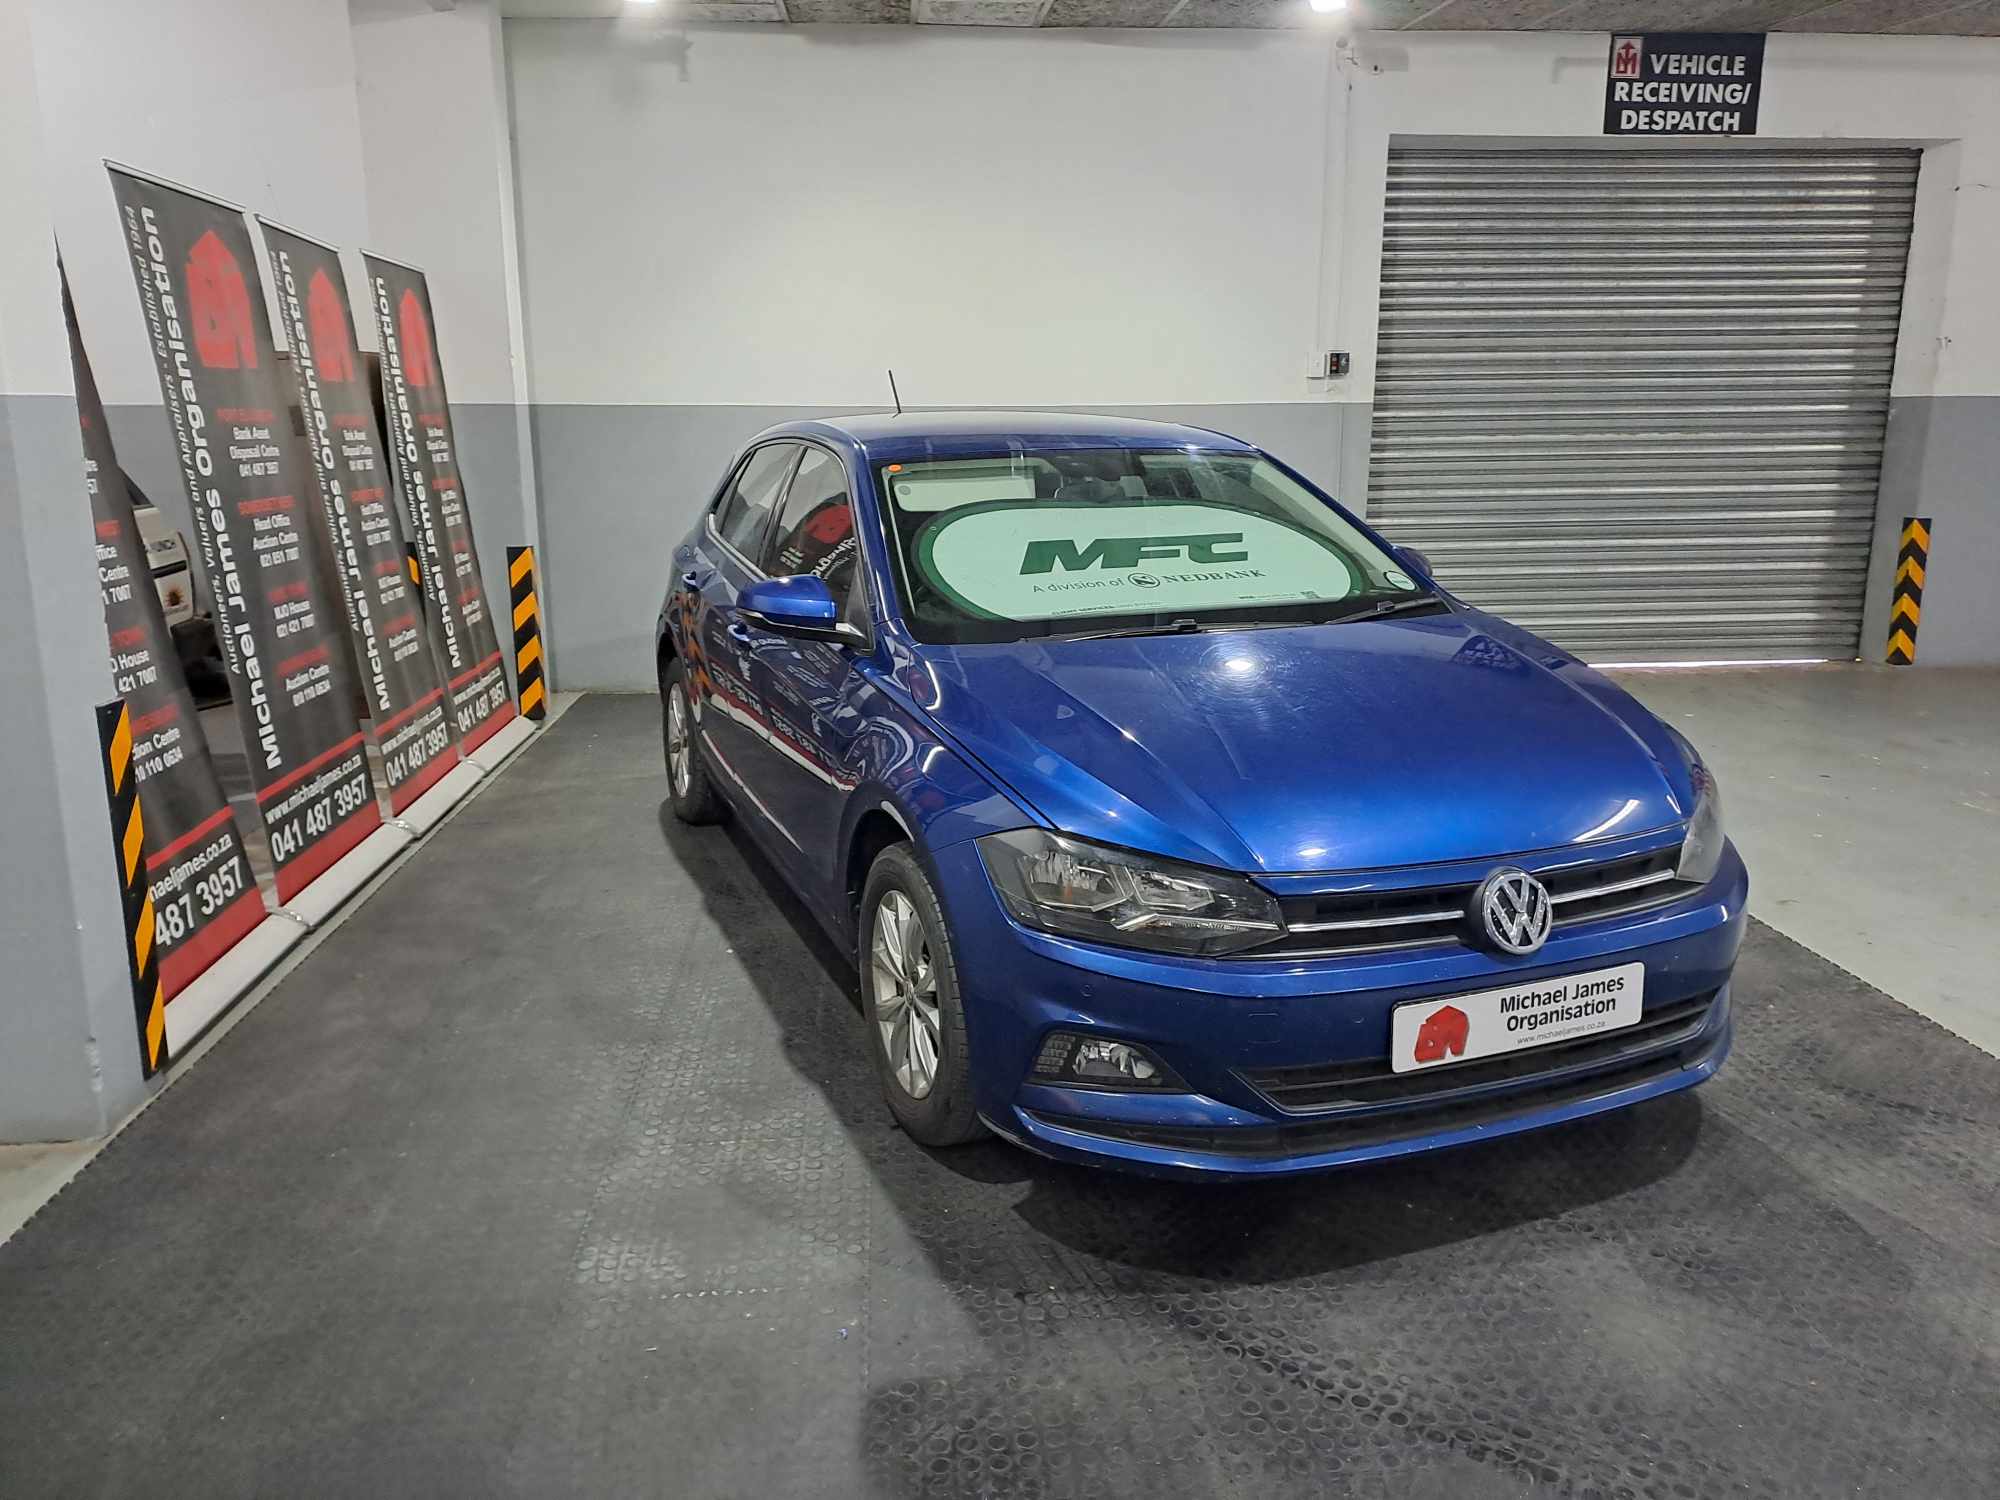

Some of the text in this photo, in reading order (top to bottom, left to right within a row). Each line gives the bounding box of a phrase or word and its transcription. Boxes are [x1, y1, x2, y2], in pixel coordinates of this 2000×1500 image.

[1614, 81, 1752, 104] RECEIVING/
[1650, 54, 1746, 76] VEHICLE
[1620, 109, 1741, 131] DESPATCH
[134, 254, 168, 358] Established
[280, 251, 334, 469] Organisation
[376, 277, 418, 463] Organisation
[164, 374, 192, 465] Appraisers
[141, 206, 282, 770] Michael James Organisation
[185, 468, 200, 502] and
[413, 471, 438, 558] James
[195, 507, 215, 568] Valuers
[330, 480, 361, 581] James
[1019, 532, 1249, 576] MFC
[1032, 583, 1045, 593] A
[1047, 580, 1107, 593] division
[1109, 577, 1126, 587] of
[1162, 569, 1267, 584] NEDBANK
[212, 574, 241, 675] Auctioneers,
[431, 564, 461, 668] Michael
[117, 650, 150, 670] House
[353, 590, 391, 711] Michael
[118, 673, 137, 692] 421
[457, 704, 476, 732] 041
[145, 756, 164, 776] 110
[386, 721, 449, 786] 041 487 3957
[271, 772, 367, 862] 041 487 3957
[156, 855, 244, 946] 487 3957
[1500, 976, 1625, 1014] Michael James
[1506, 997, 1617, 1032] Organisation
